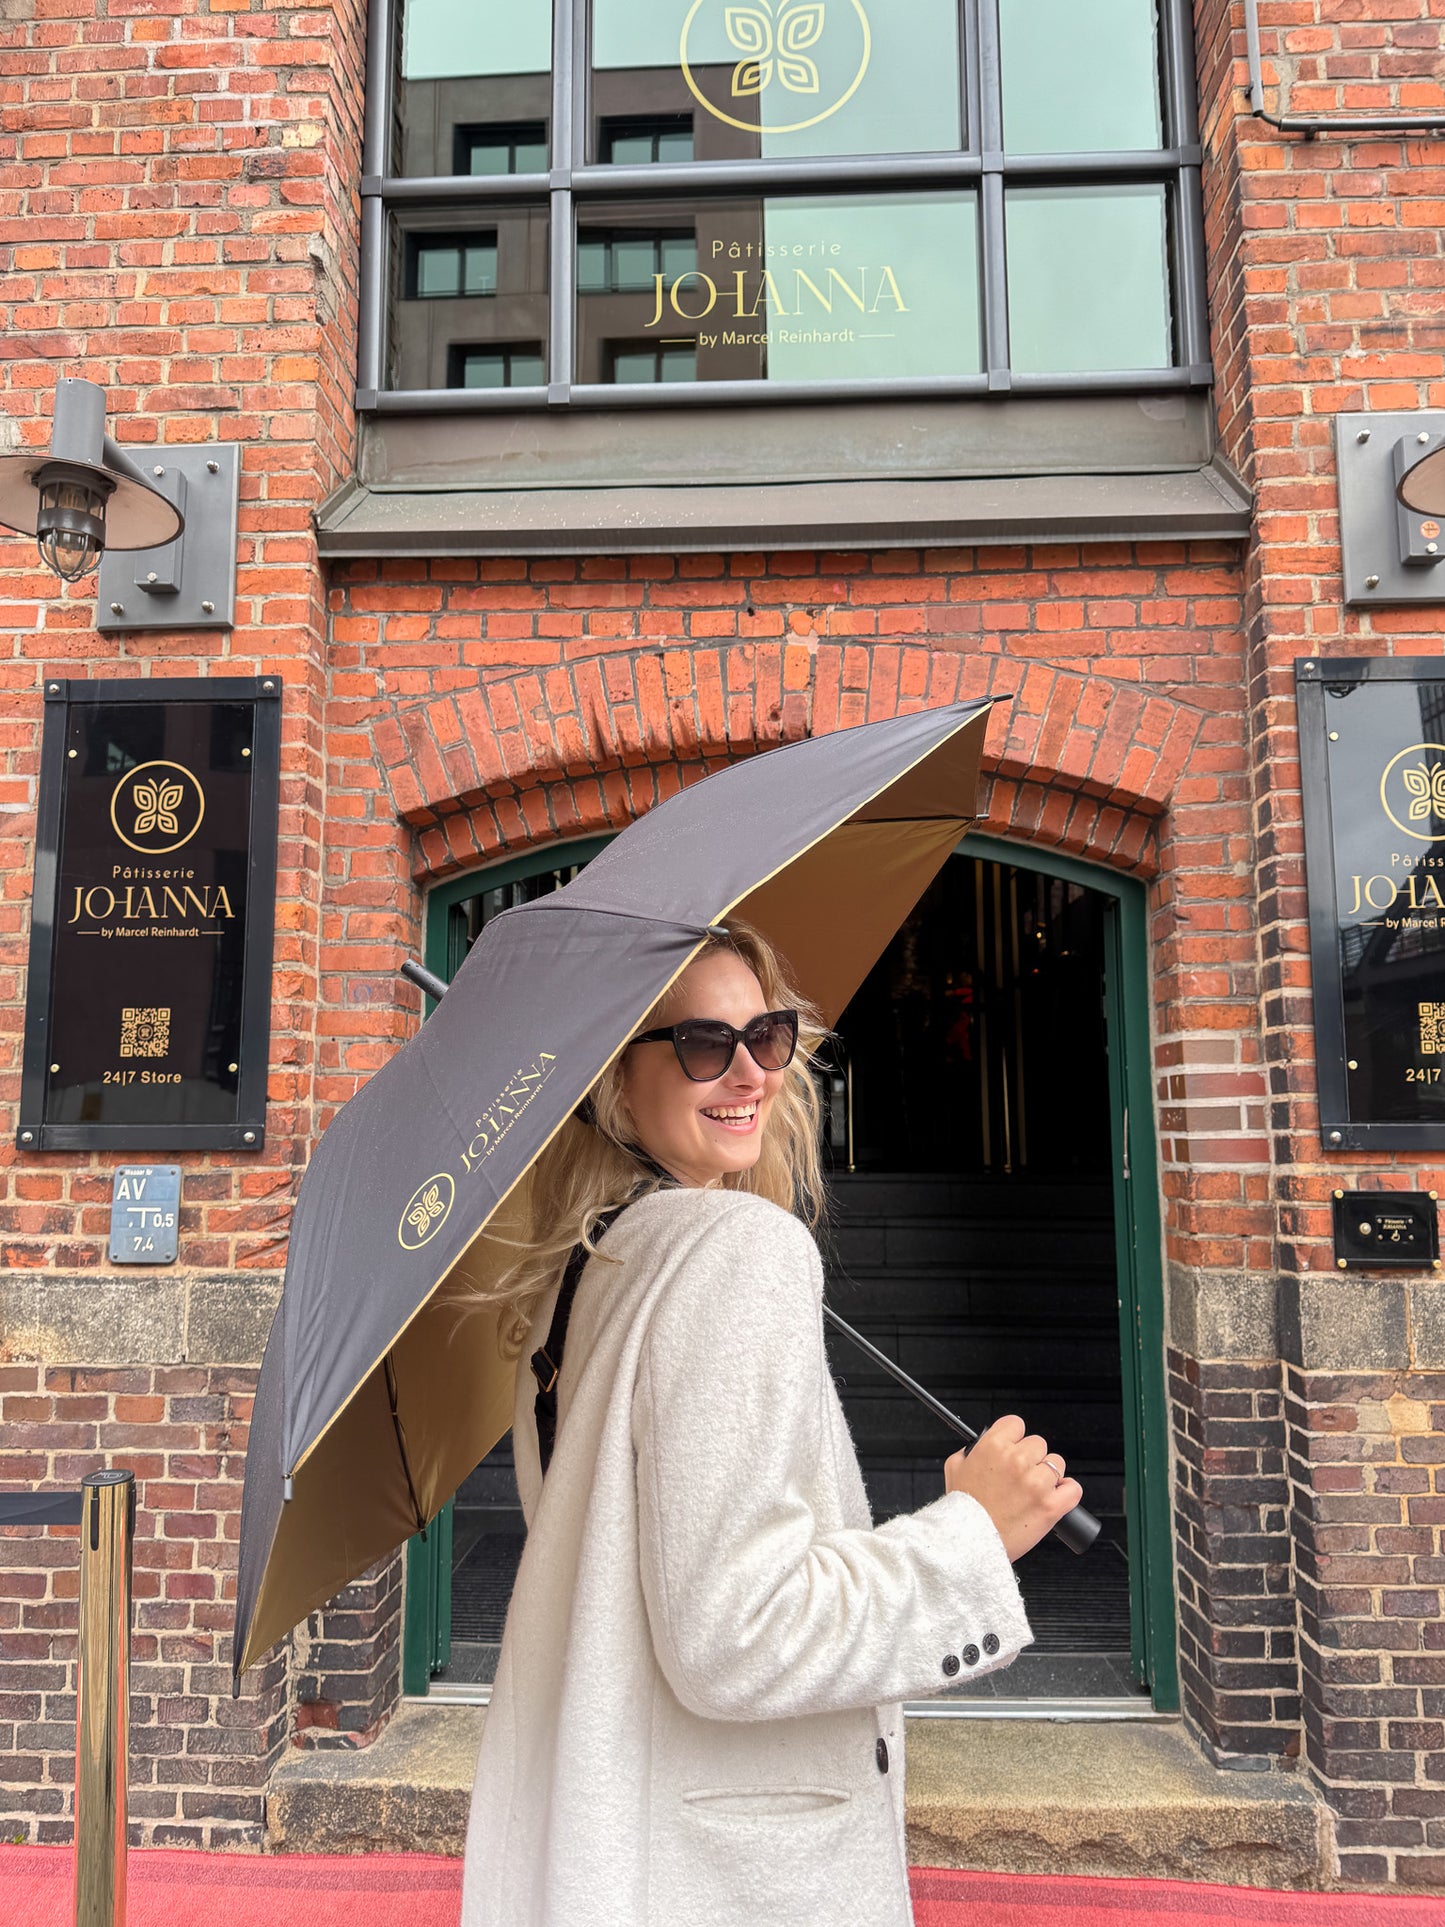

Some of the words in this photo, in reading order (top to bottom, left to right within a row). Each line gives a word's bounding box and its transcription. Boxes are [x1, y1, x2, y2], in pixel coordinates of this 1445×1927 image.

[711, 240, 842, 259] Pâtisserie
[644, 265, 911, 328] JOHANNA
[699, 332, 719, 348] by
[722, 330, 773, 345] Marcel
[779, 329, 855, 344] Reinhardt
[1391, 852, 1445, 868] Pâtiss
[112, 865, 195, 879] Pâtisserie
[67, 885, 236, 924] JOHANNA
[101, 927, 114, 939] by
[116, 927, 149, 937] Marcel
[151, 926, 200, 937] Reinhardt
[1386, 917, 1400, 930] by
[1402, 917, 1438, 928] Marcel
[102, 1070, 137, 1086] 24|7
[140, 1070, 182, 1084] Store
[460, 1052, 557, 1175] JOHANNA
[486, 1145, 496, 1156] by
[494, 1119, 515, 1146] Marcel
[514, 1083, 543, 1120] Reinhardt
[116, 1178, 147, 1200] AV
